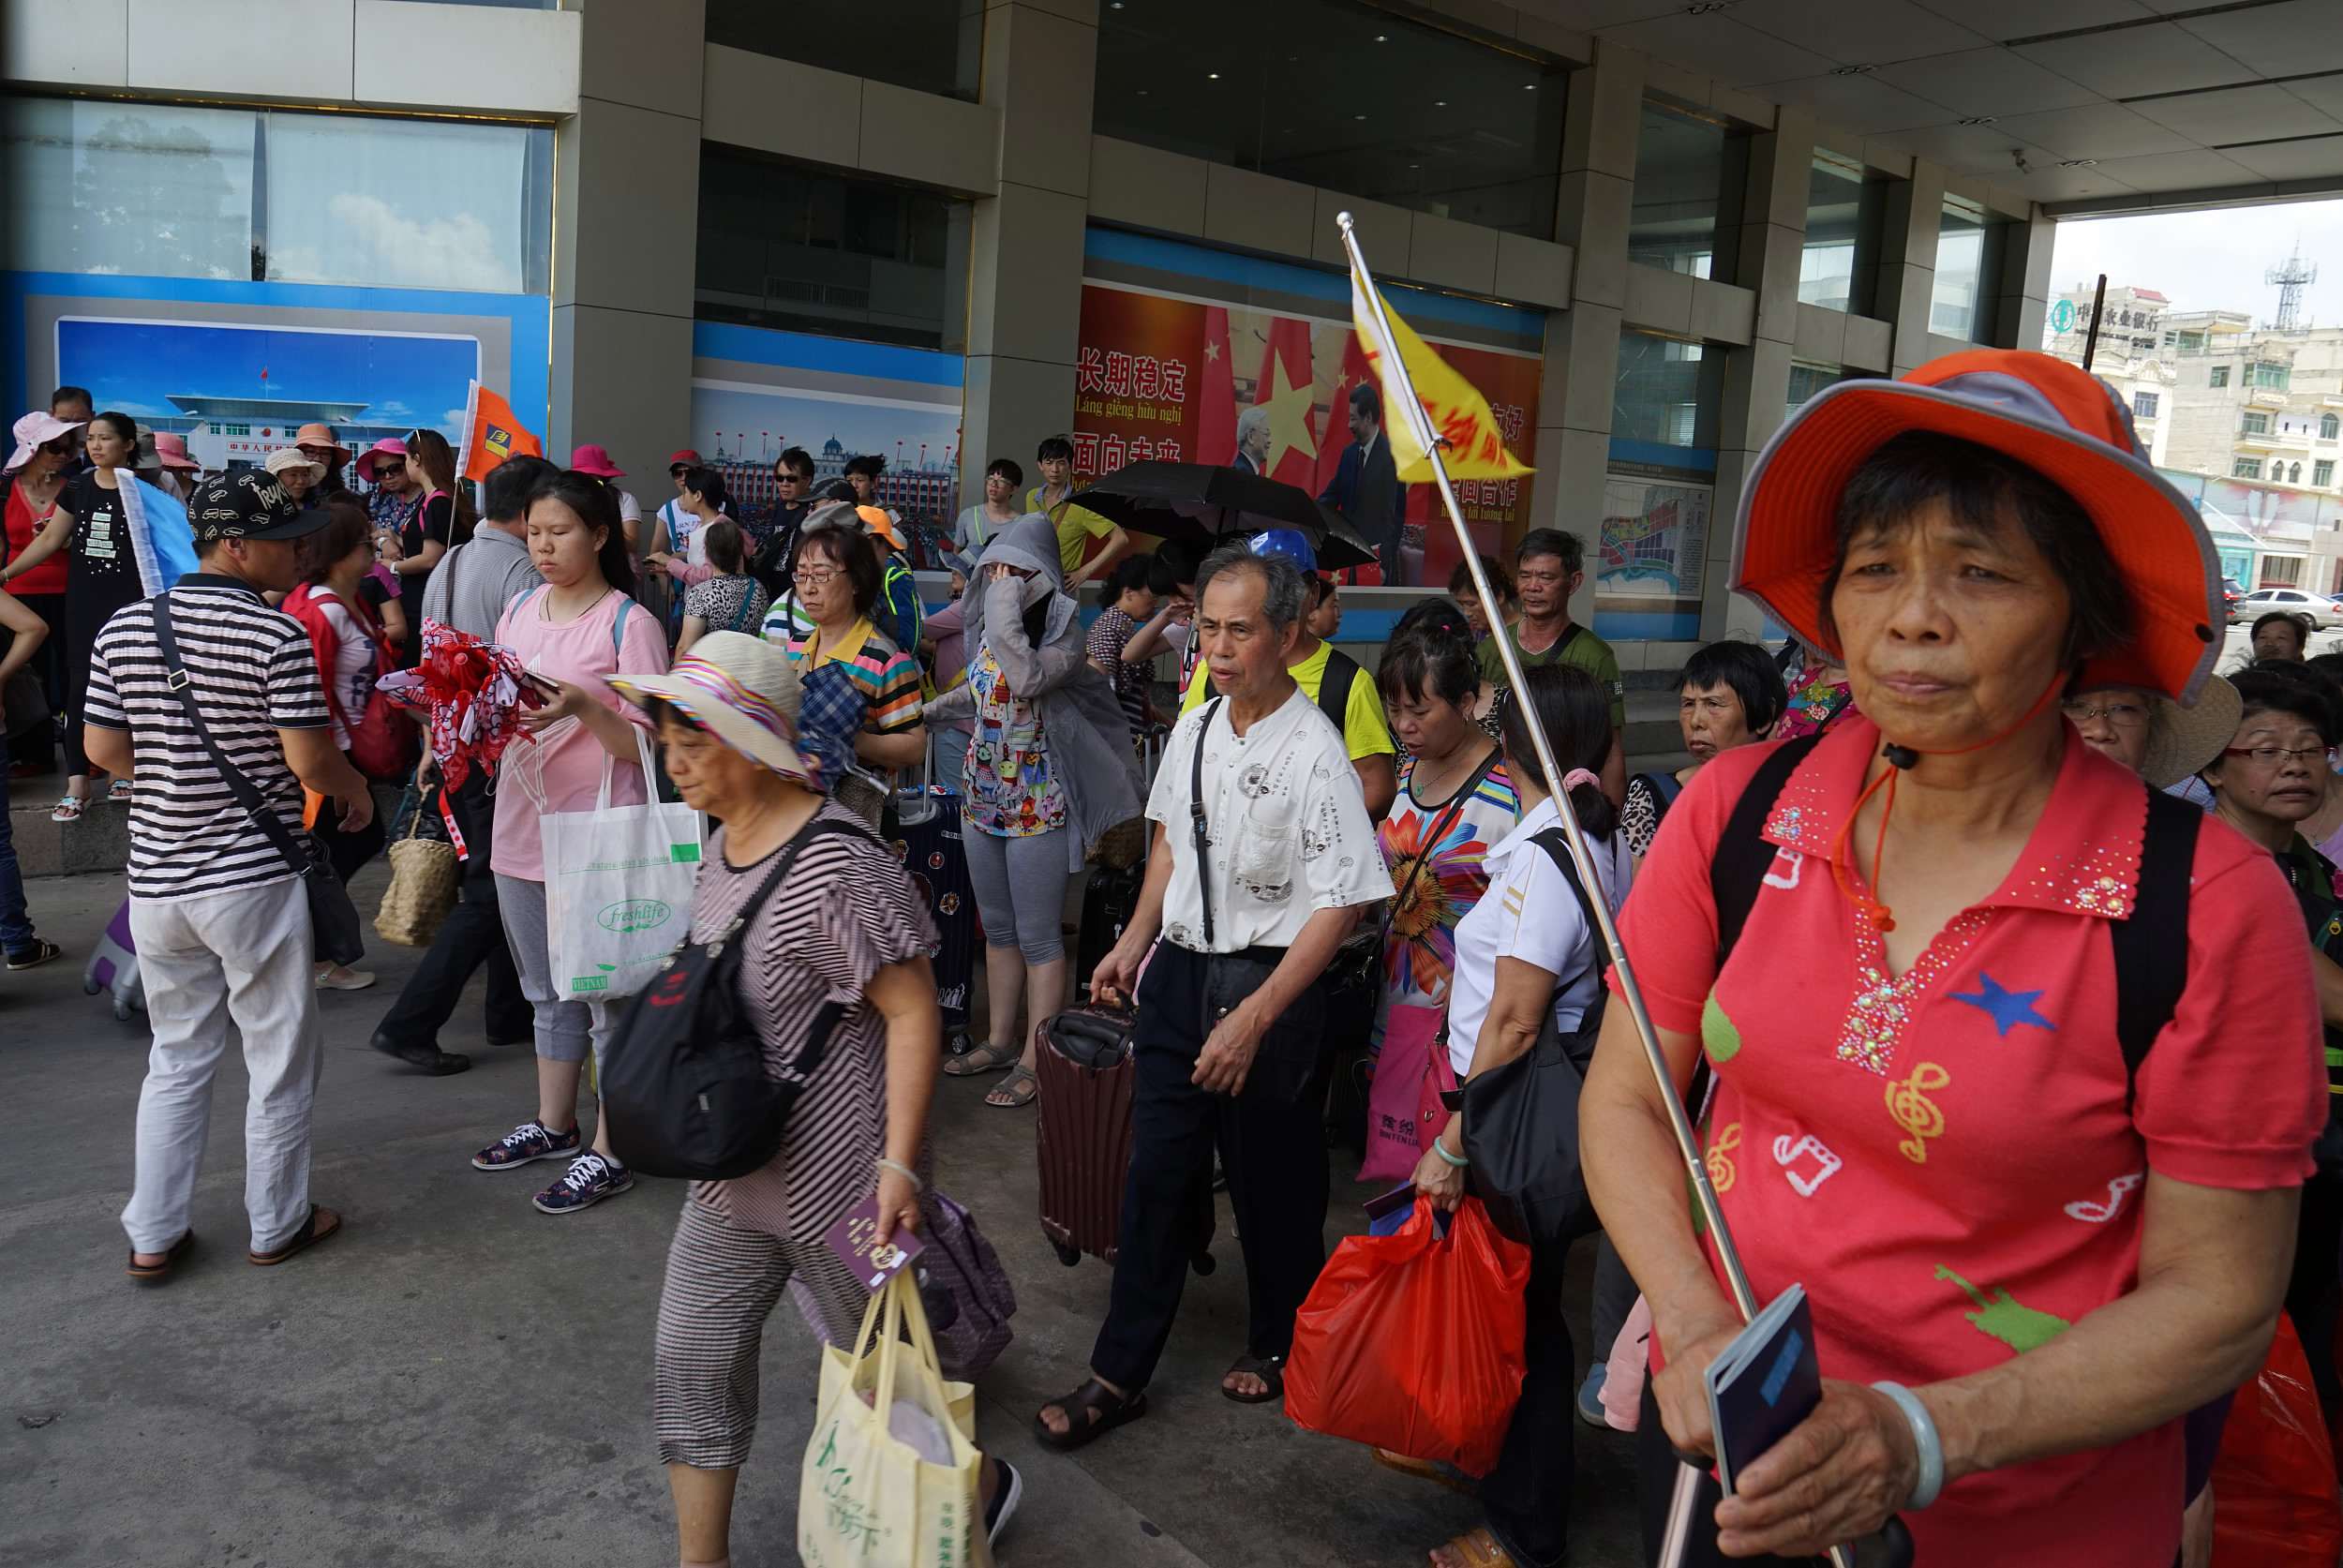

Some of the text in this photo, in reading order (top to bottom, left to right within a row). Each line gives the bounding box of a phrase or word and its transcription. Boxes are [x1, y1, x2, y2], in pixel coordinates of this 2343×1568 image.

[2076, 302, 2160, 333] 中农业银行
[1077, 347, 1187, 403] 长期稳定
[573, 977, 606, 991] VIETNAM
